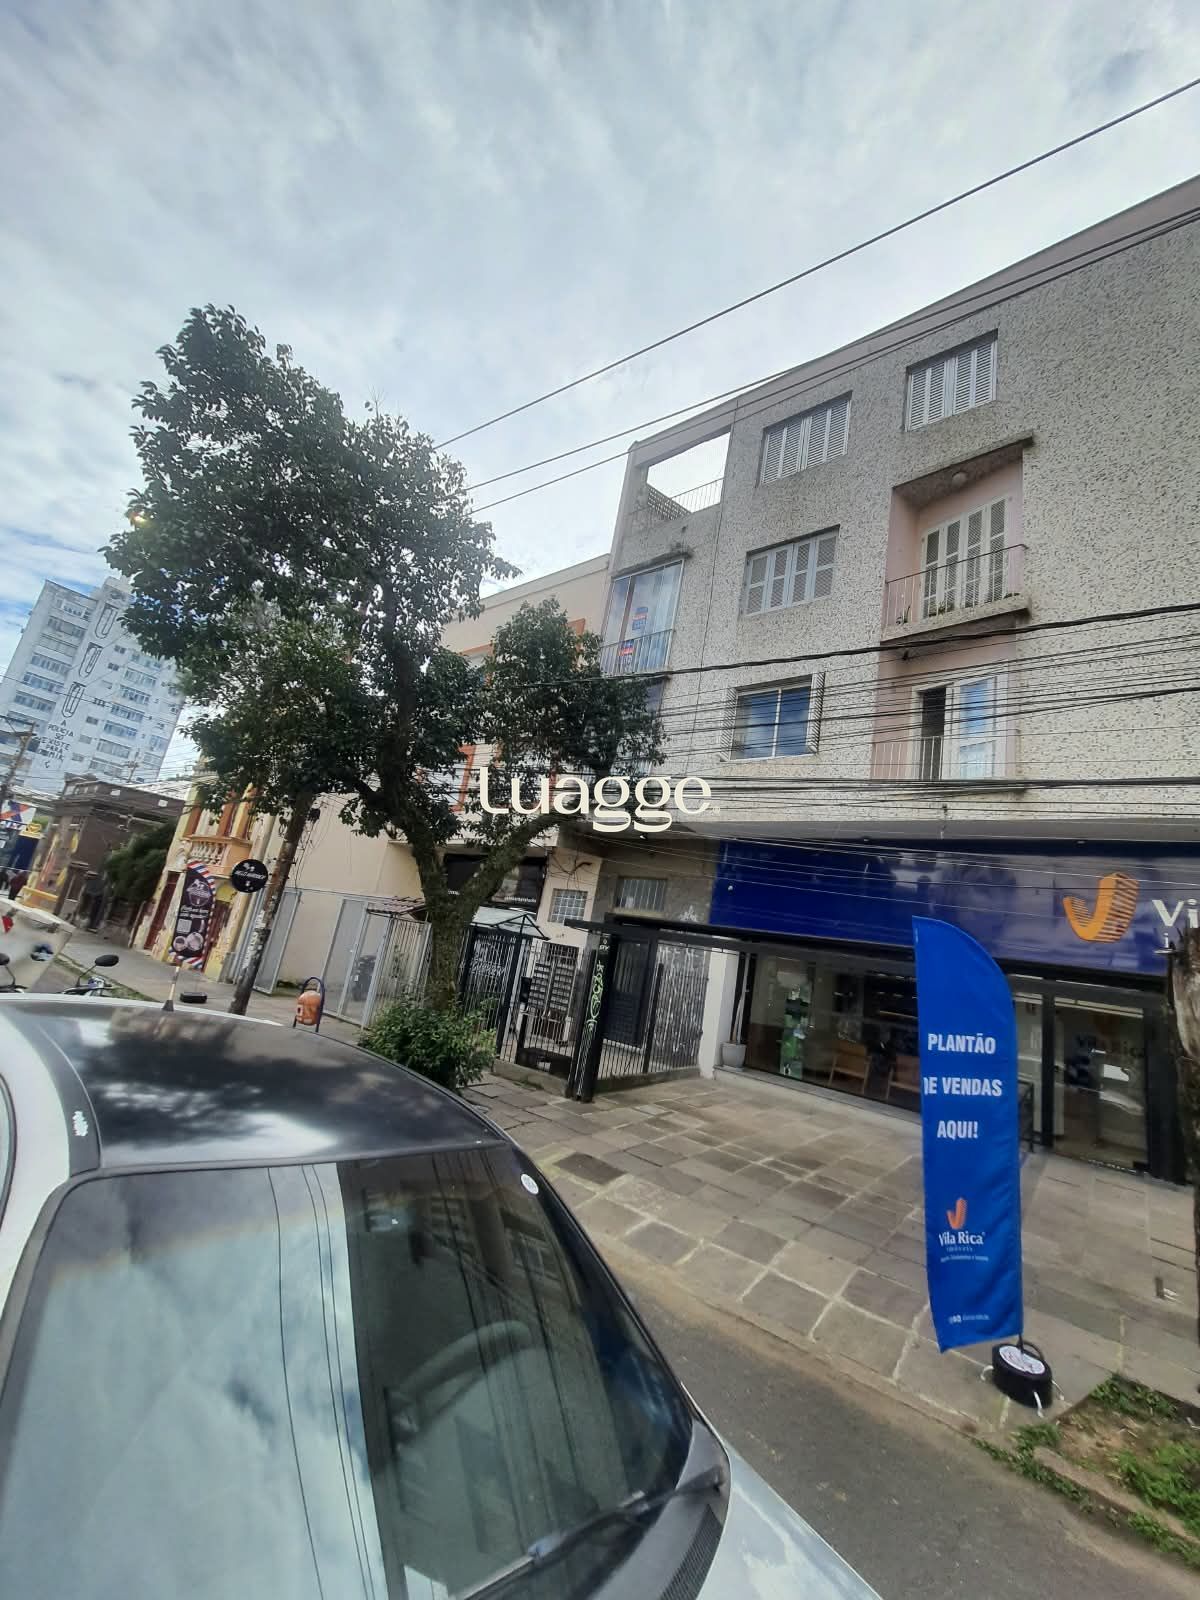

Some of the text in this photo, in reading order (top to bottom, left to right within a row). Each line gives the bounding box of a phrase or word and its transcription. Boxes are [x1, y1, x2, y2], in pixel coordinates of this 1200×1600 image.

[927, 1033, 996, 1054] PLANTÃO
[942, 1077, 1003, 1097] VENDAS
[937, 1120, 979, 1140] AQUI!
[939, 1231, 984, 1247] Vila Rica
